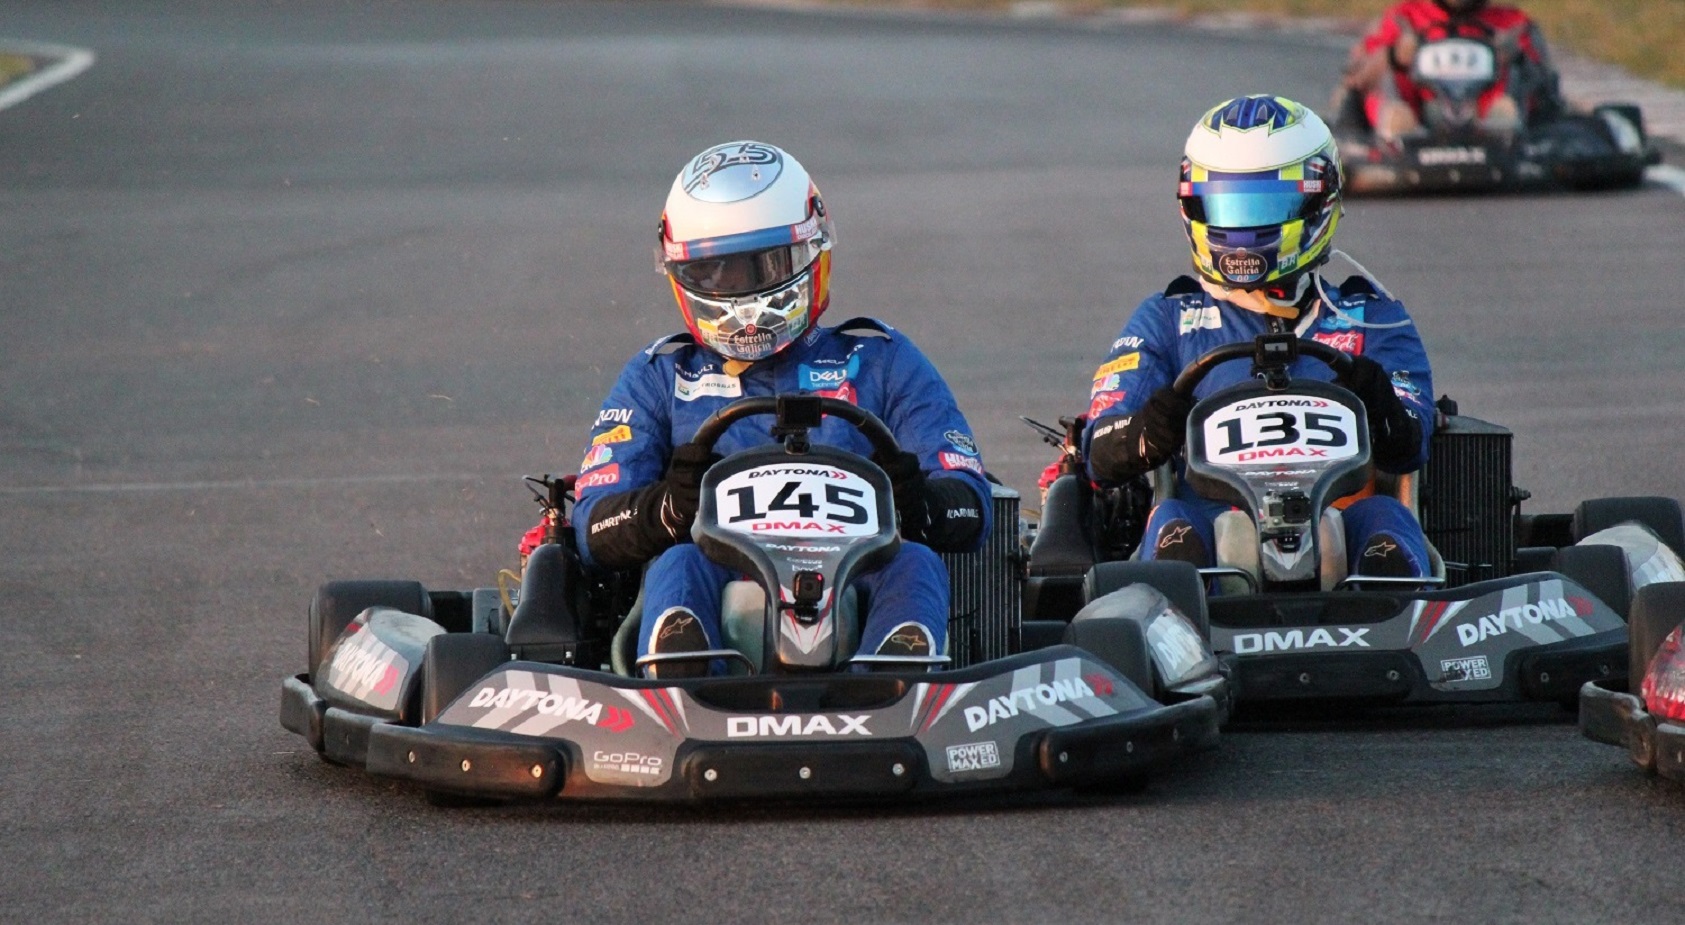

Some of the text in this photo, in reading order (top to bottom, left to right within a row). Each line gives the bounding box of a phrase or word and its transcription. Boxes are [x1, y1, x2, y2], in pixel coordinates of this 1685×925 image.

[1225, 256, 1260, 268] Estrella
[1227, 265, 1260, 275] Galicia
[1235, 400, 1311, 411] DAYTONA
[1216, 412, 1348, 455] 135
[1238, 448, 1328, 462] DMAX
[748, 468, 829, 479] DAYTONA
[726, 481, 869, 525] 145
[752, 522, 847, 534] DMAX
[765, 543, 841, 552] DAYTONA
[1456, 598, 1578, 647] DAYTONA
[1233, 627, 1371, 654] DMAX
[1445, 659, 1487, 671] POWER
[468, 687, 603, 726] DAYTONA
[964, 674, 1095, 733] DAYTONA
[727, 715, 873, 738] DMAX
[594, 751, 662, 766] GoPro
[949, 744, 995, 760] POWER
[952, 753, 997, 770] MAXED
